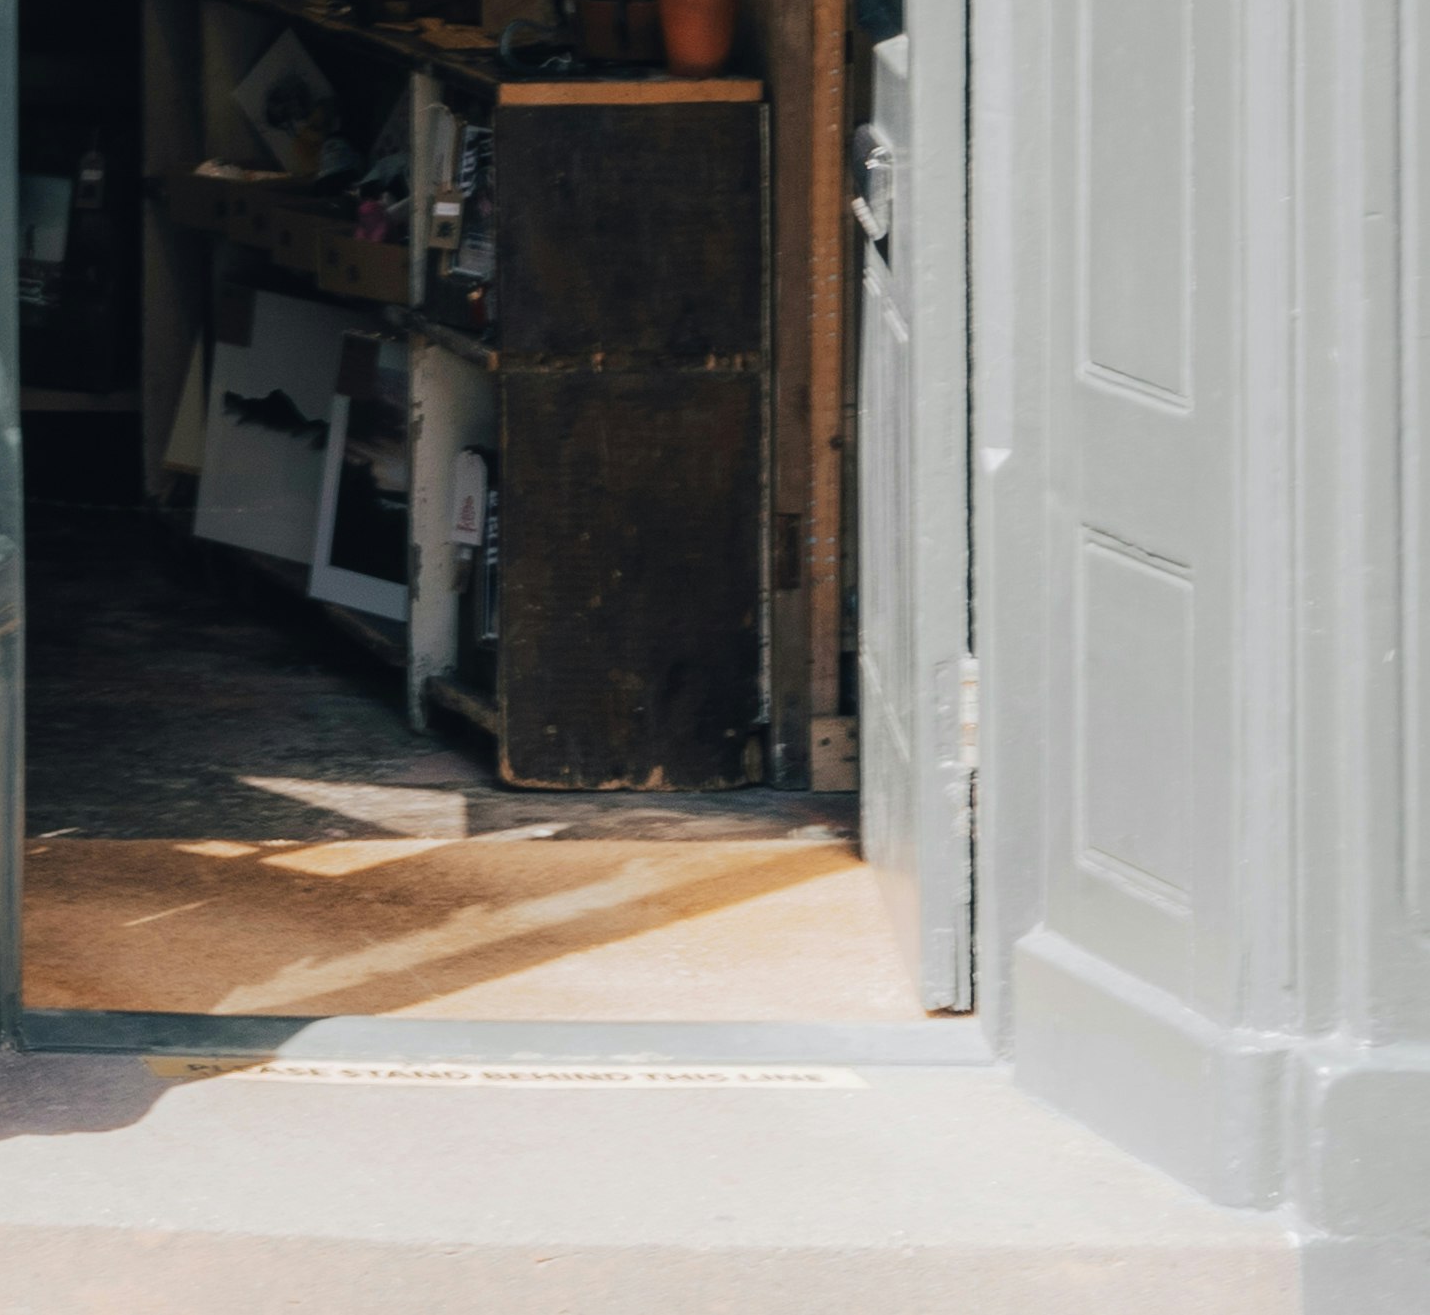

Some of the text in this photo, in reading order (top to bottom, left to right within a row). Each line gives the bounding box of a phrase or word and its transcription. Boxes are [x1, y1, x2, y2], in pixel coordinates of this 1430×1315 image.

[340, 1068, 471, 1080] STAND
[481, 1070, 632, 1082] BEHIND
[639, 1071, 729, 1082] THIS
